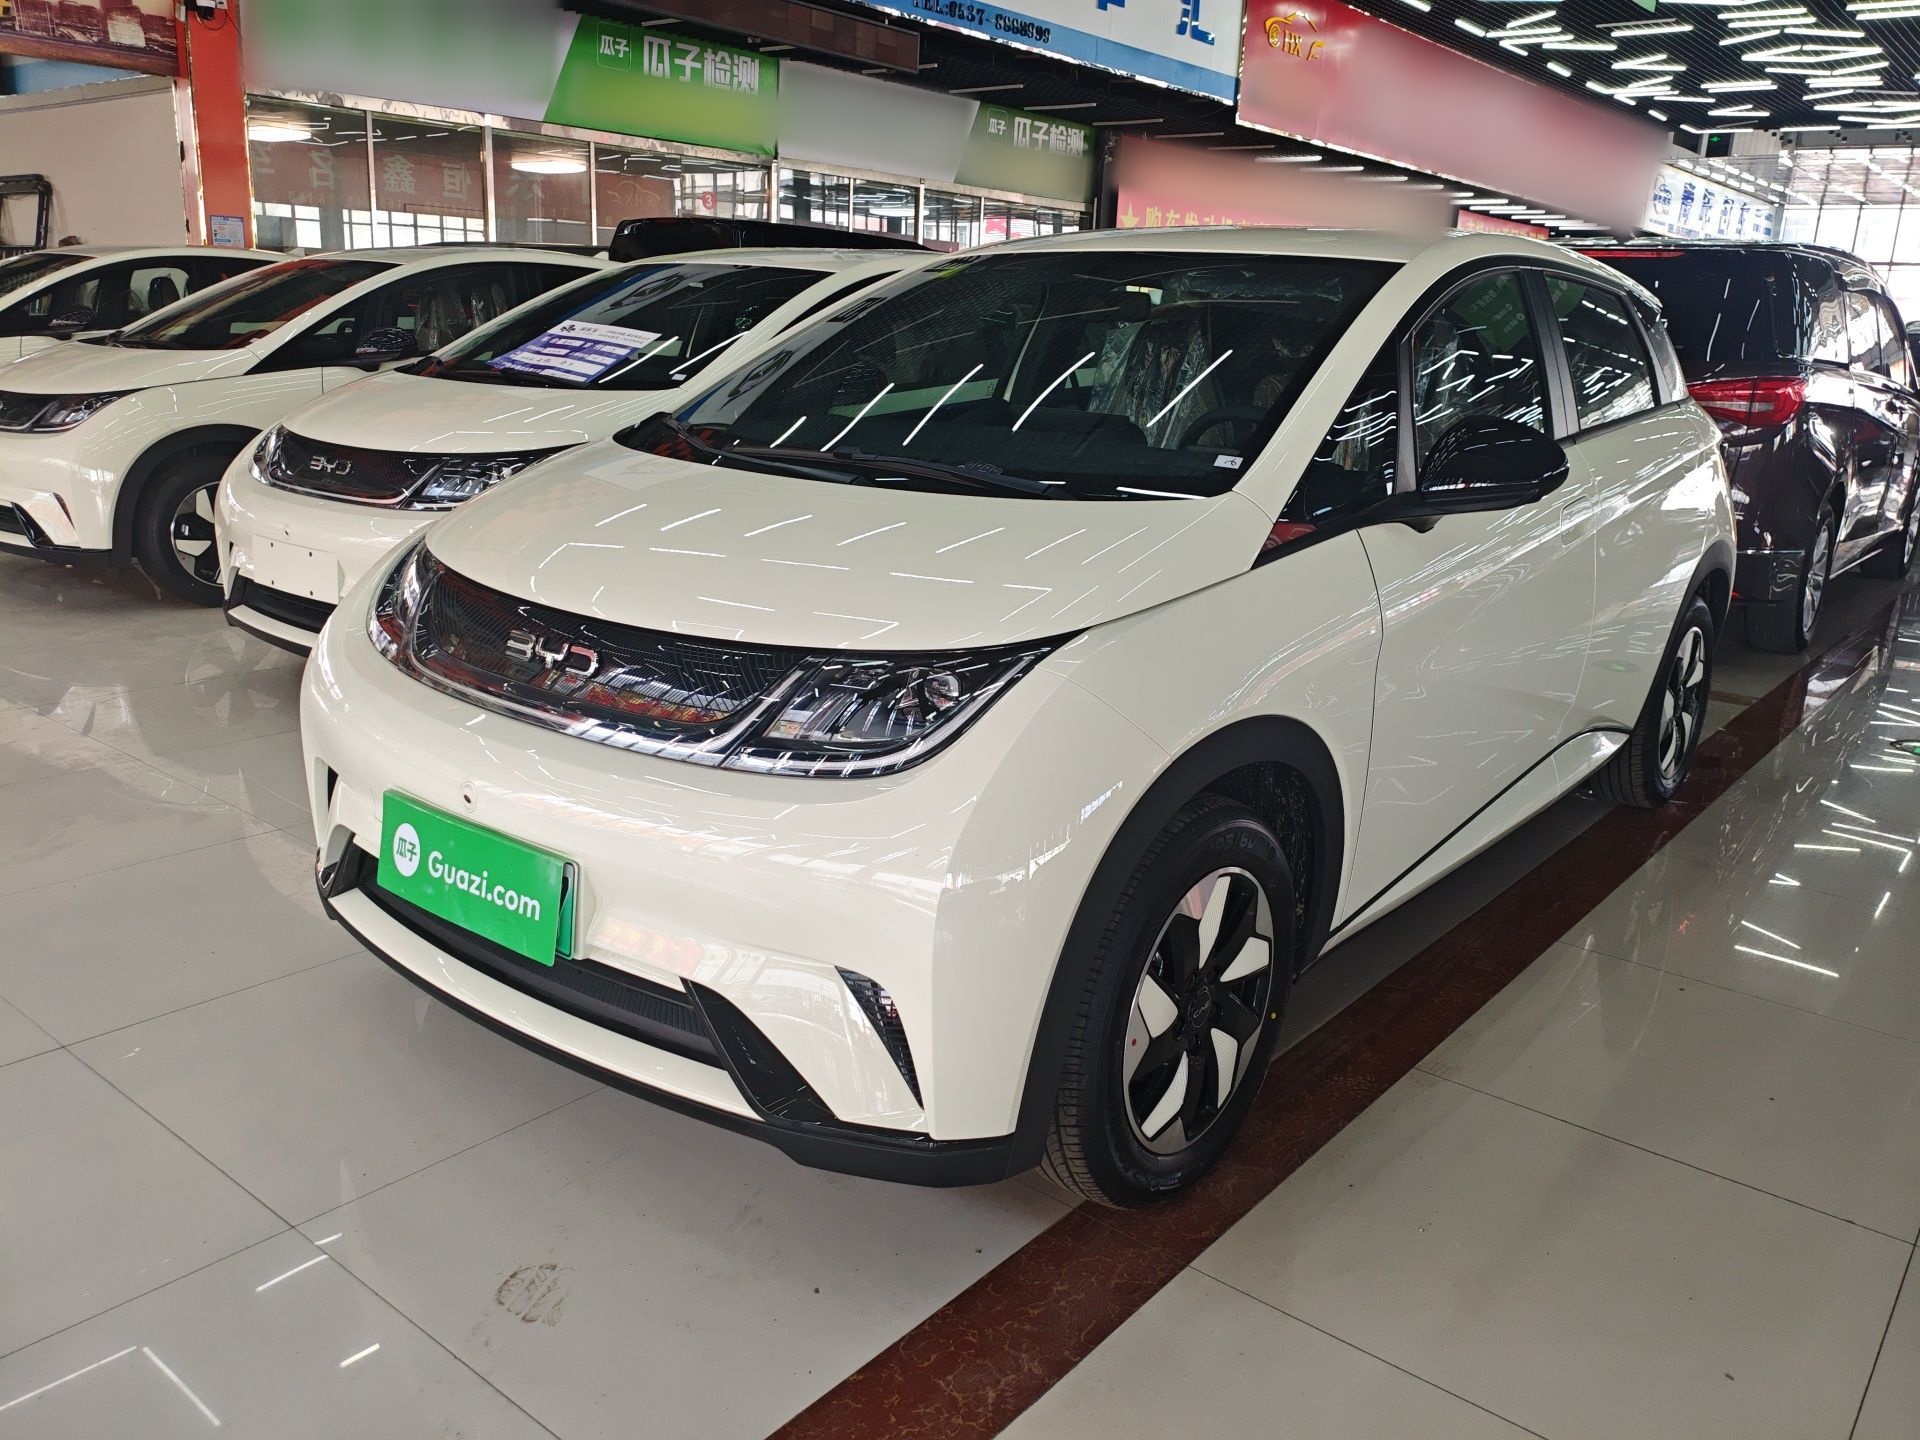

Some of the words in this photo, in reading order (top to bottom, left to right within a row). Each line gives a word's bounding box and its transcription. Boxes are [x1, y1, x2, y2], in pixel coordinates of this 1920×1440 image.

[599, 34, 630, 59] 瓜子
[643, 35, 760, 96] 瓜子检测
[988, 117, 1007, 136] 瓜子
[1013, 116, 1085, 159] 瓜子检测
[705, 194, 713, 208] 3
[310, 455, 352, 476] BYD
[505, 629, 599, 679] BYD
[396, 836, 418, 862] 瓜子
[427, 850, 542, 922] Guazi.com
